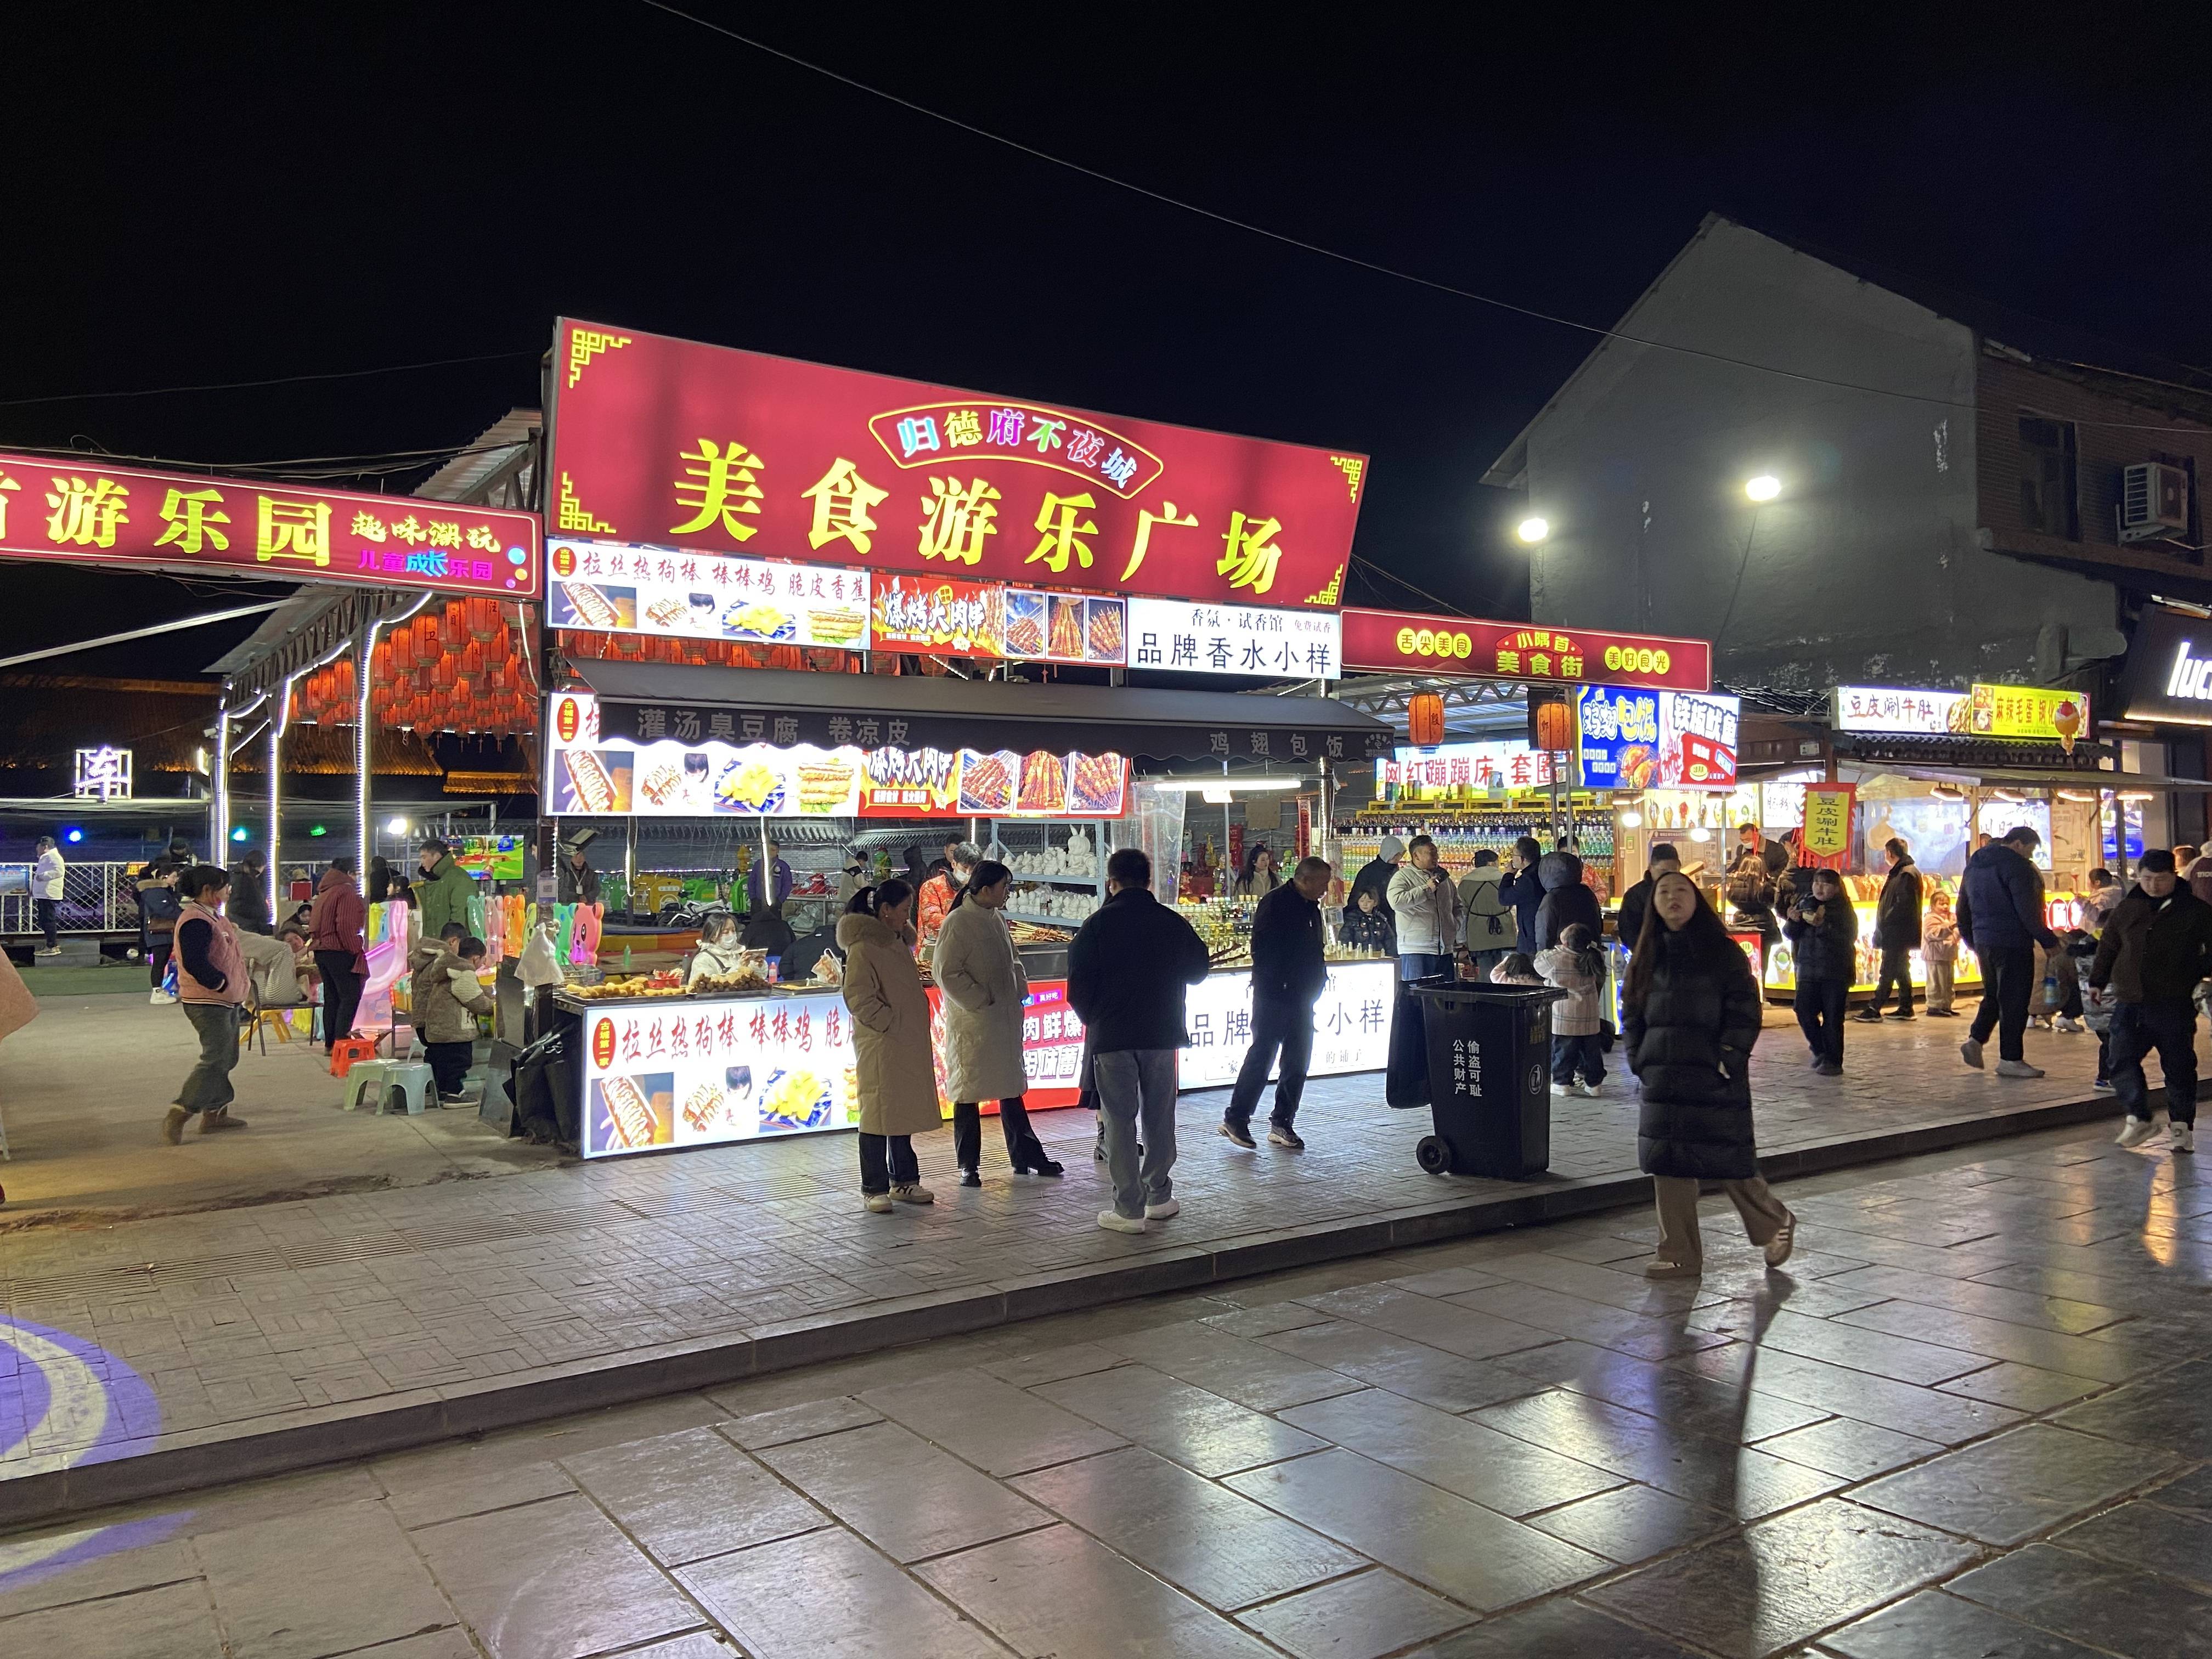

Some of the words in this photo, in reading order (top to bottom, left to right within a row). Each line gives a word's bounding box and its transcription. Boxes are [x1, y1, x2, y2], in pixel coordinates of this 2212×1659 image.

[898, 408, 1137, 490] 归德府不夜城
[351, 510, 501, 552] 趣味潮玩
[670, 438, 1283, 594] 美食游乐广场
[358, 549, 493, 580] 儿童成长乐园
[582, 551, 701, 583] 拉丝热狗棒
[712, 561, 775, 595] 棒棒鸡
[788, 573, 867, 602] 脆皮香蕉
[884, 591, 986, 641] 爆烤大肉串
[1137, 632, 1331, 675] 品牌香水小样
[1400, 634, 1468, 653] 舌尖美食
[1497, 650, 1582, 678] 美食街
[1608, 650, 1666, 670] 美好食光
[2167, 640, 2212, 700] luc
[637, 708, 798, 744] 灌汤臭豆腐
[828, 716, 911, 746] 卷凉皮
[1583, 697, 1656, 741] 鸡翅包饭
[1673, 693, 1738, 748] 铁板鱿鱼
[1847, 694, 1934, 723] 豆皮涮牛肚
[1996, 696, 2033, 724] 麻辣毛蛋
[1210, 731, 1343, 758] 鸡翅包饭
[1385, 755, 1494, 787] 网红蹦蹦床
[1814, 798, 1840, 845] 豆皮涮牛肚
[622, 1008, 738, 1064] 拉丝热狗棒
[749, 1004, 812, 1053] 棒棒鸡
[1453, 1039, 1466, 1094] 公共财产
[1468, 1040, 1482, 1097] 偷盗可耻
